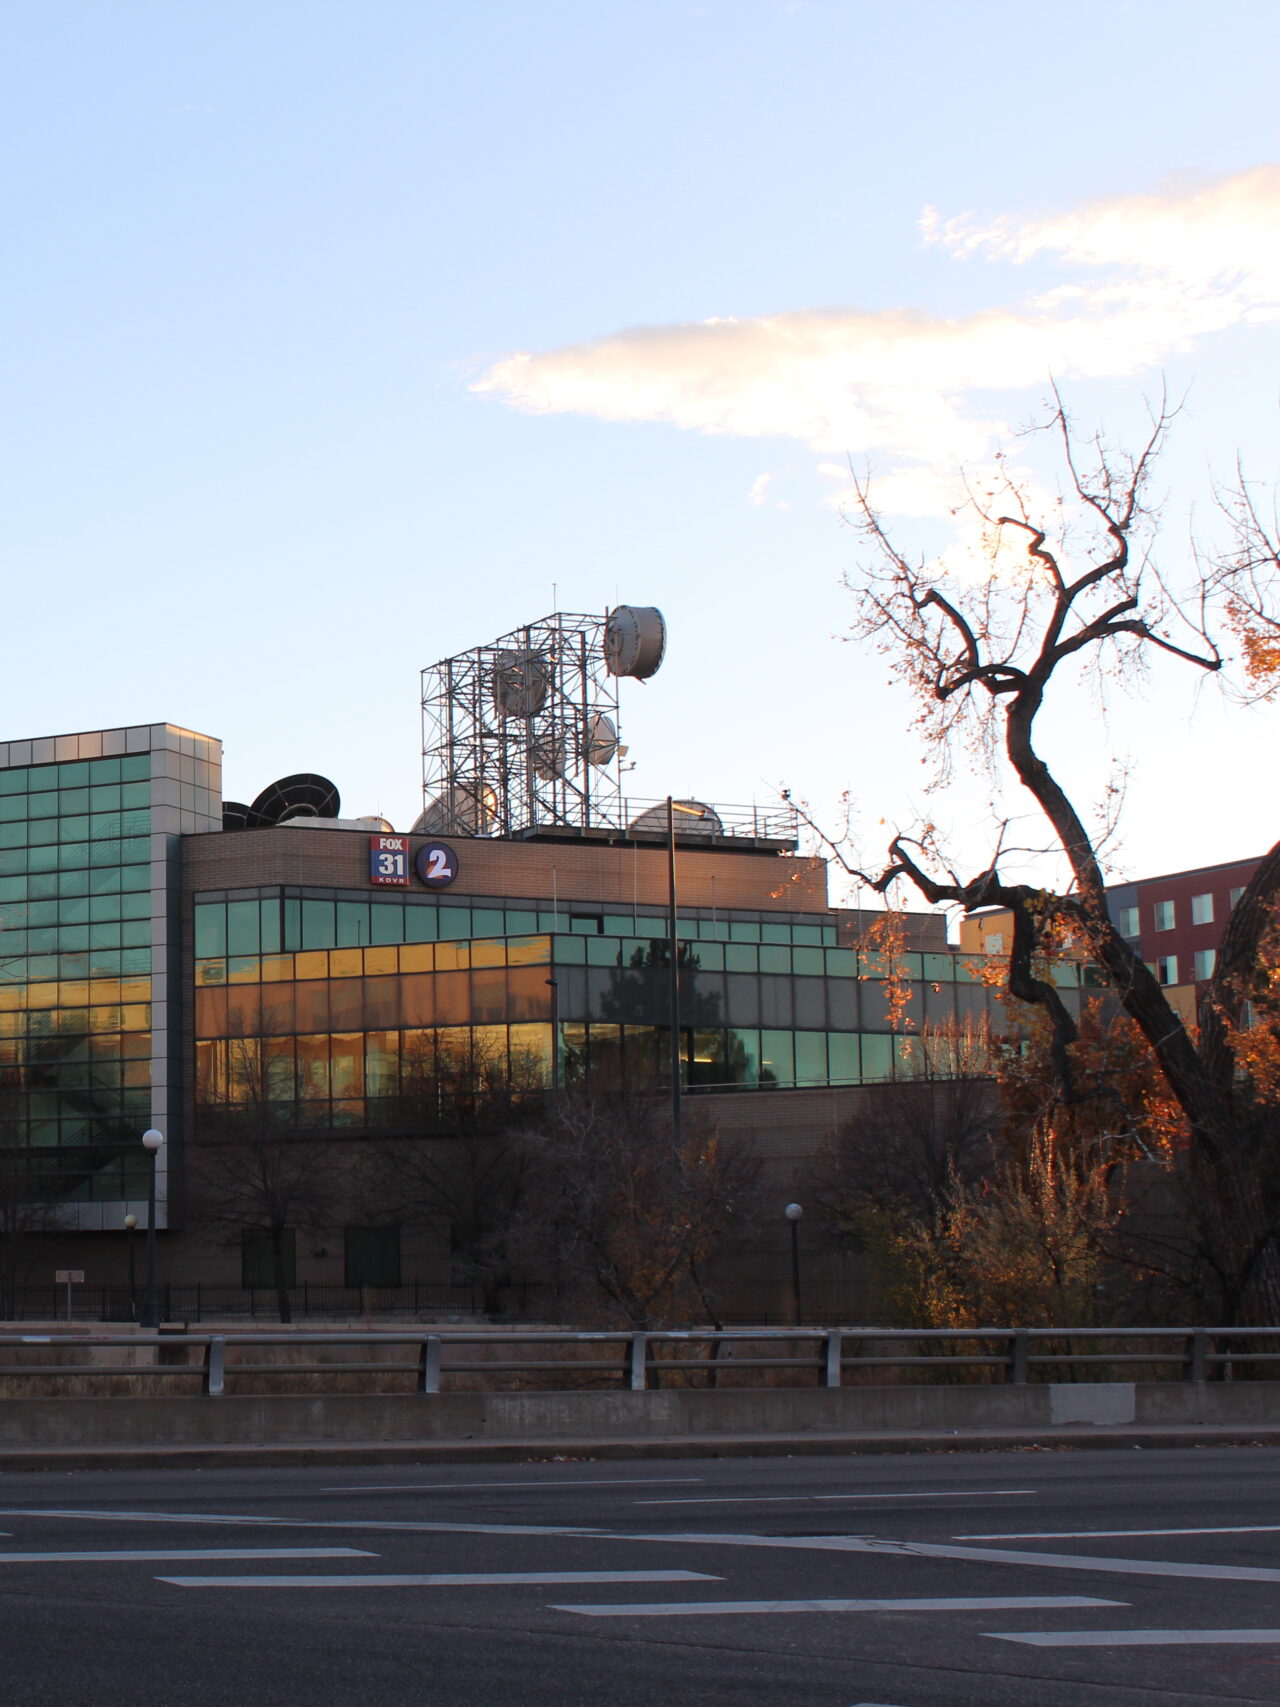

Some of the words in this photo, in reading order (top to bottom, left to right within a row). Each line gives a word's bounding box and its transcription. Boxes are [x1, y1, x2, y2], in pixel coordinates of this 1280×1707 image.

[379, 838, 403, 850] FOX
[378, 853, 403, 875] 31
[427, 849, 452, 878] 2
